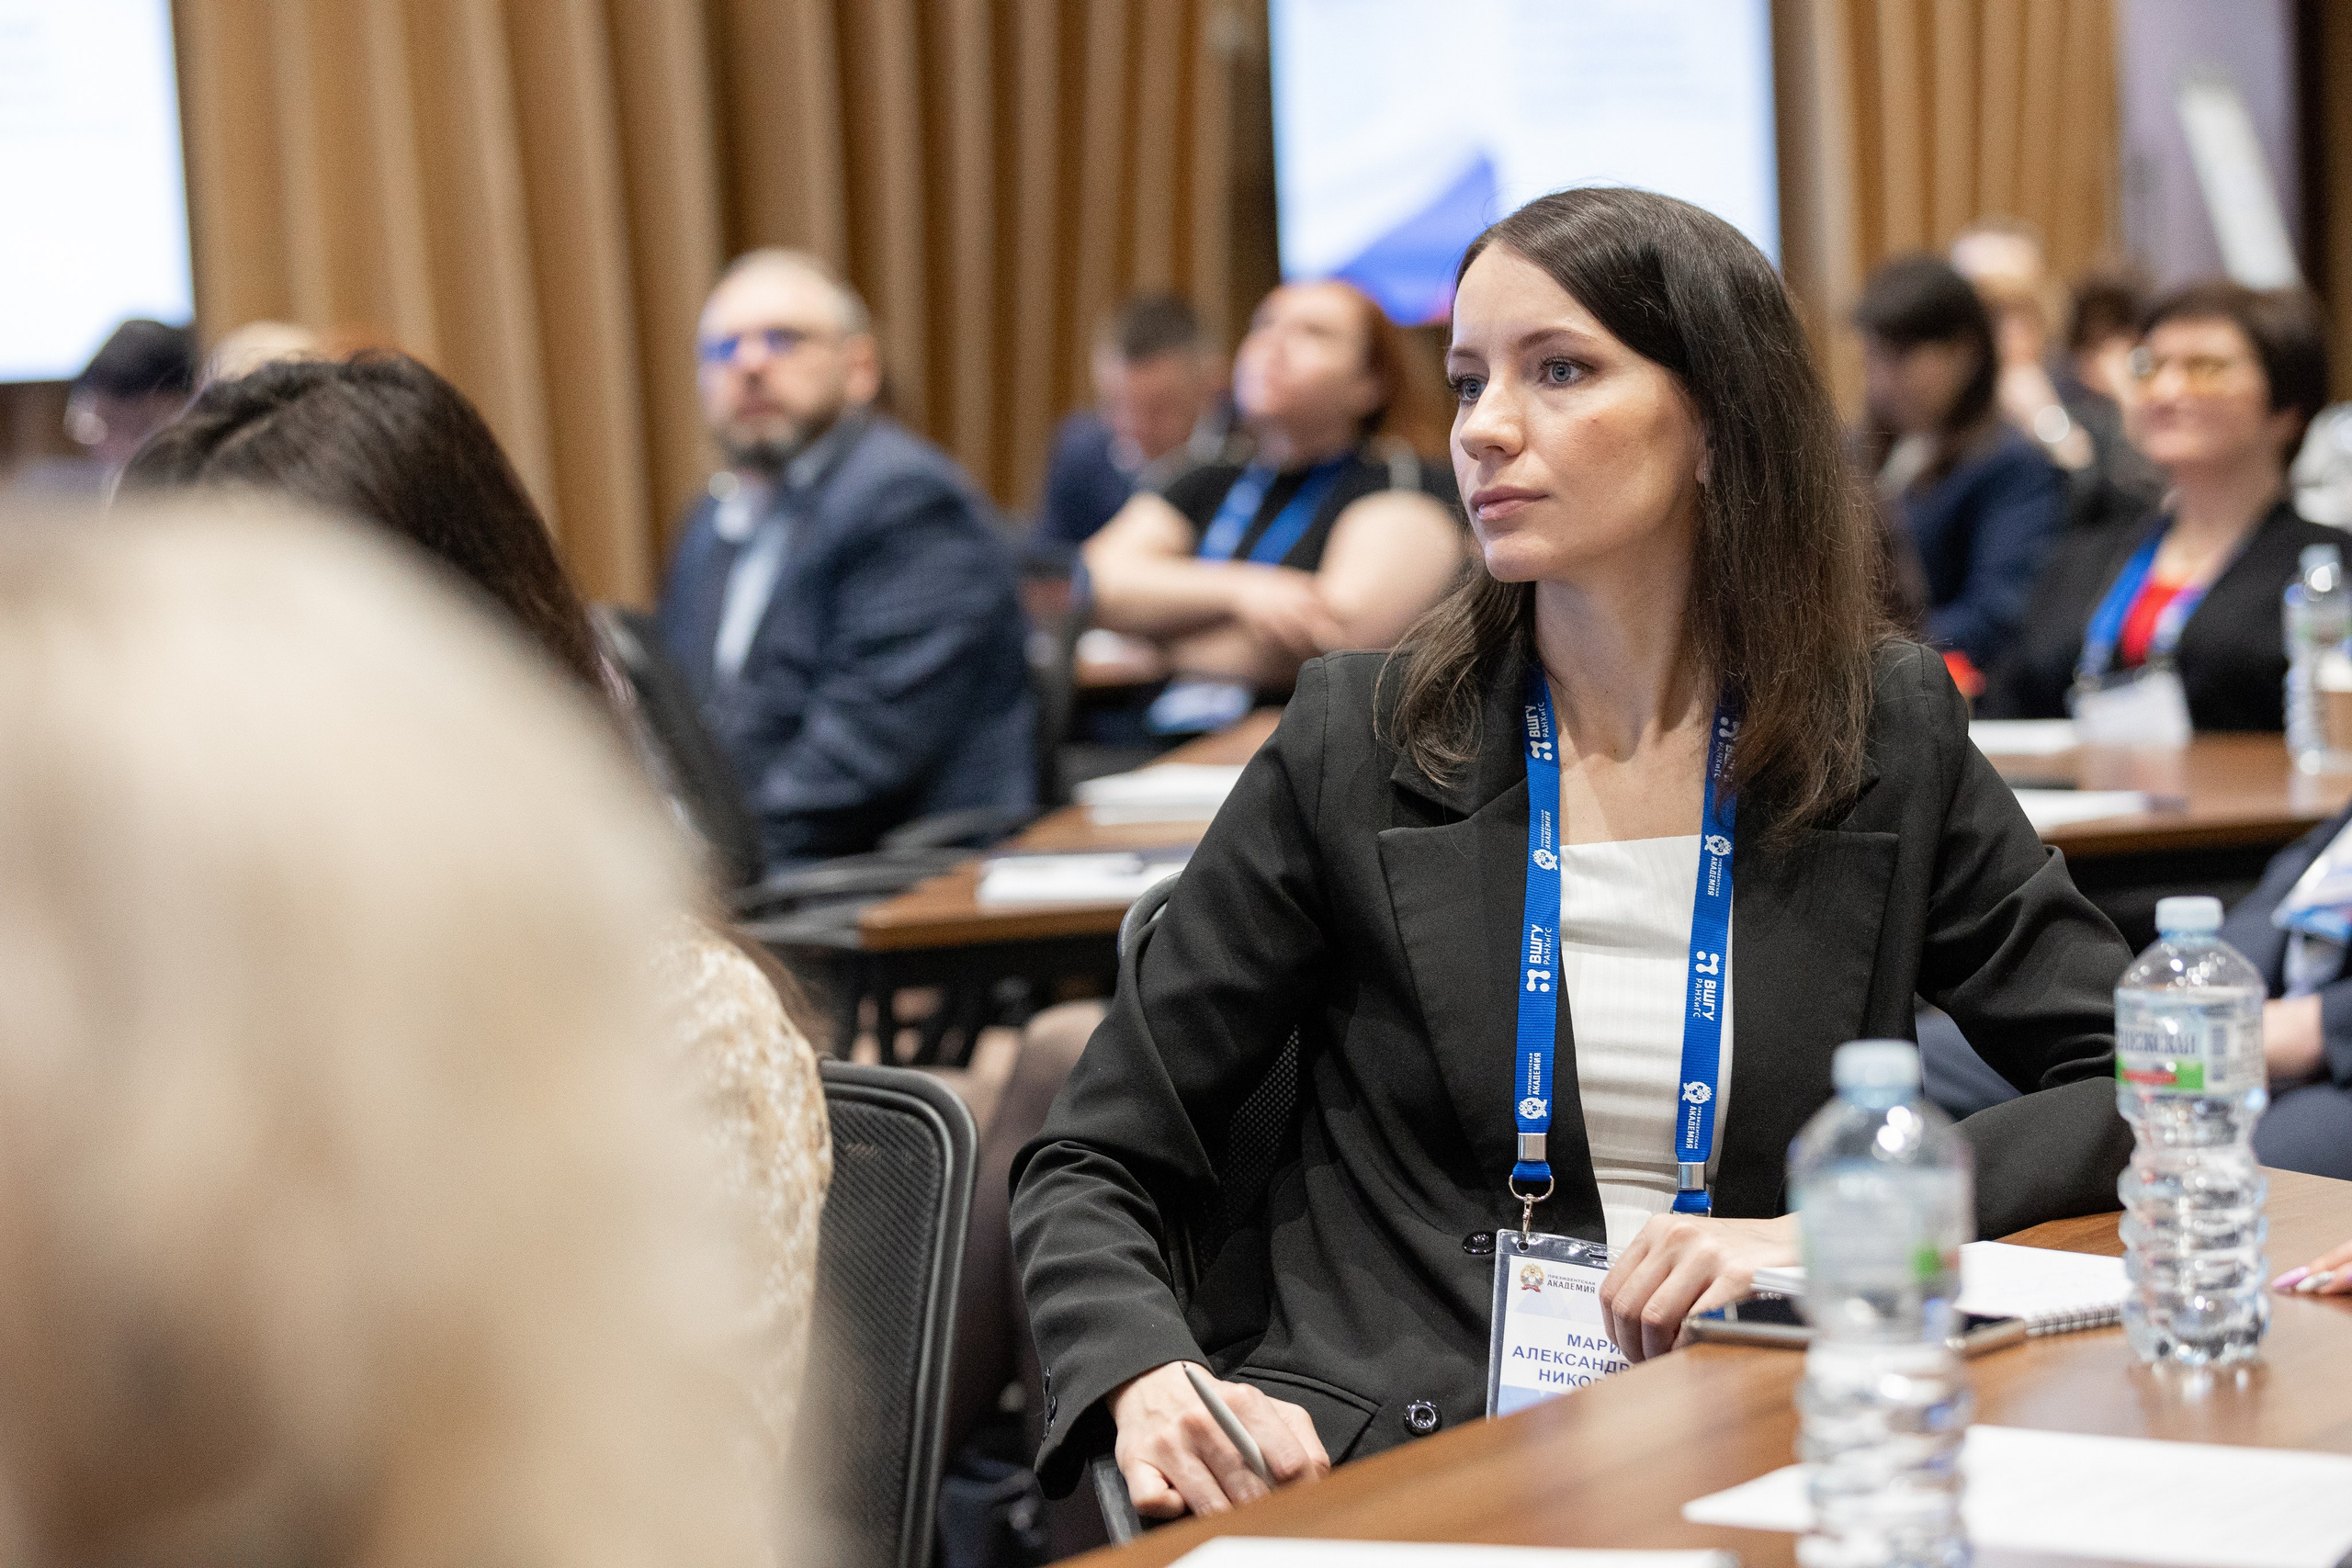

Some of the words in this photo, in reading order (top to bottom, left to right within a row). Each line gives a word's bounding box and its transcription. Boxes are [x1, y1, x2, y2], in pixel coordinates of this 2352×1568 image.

[1525, 705, 1541, 738] ВШГУ
[1707, 855, 1718, 897] АКАДЕМИЯ
[1529, 923, 1544, 964] ВШГУ
[1543, 927, 1553, 965] РАНХиГС
[1692, 977, 1703, 1019] РАНХиГС
[1702, 979, 1717, 1021] ВШГУ
[1532, 1052, 1542, 1096] АКАДЕМИЯ
[1685, 1105, 1697, 1149] АКАДЕМИЯ
[1546, 1280, 1596, 1294] АКАДЕМИЯ
[1539, 1369, 1603, 1388] НИКО
